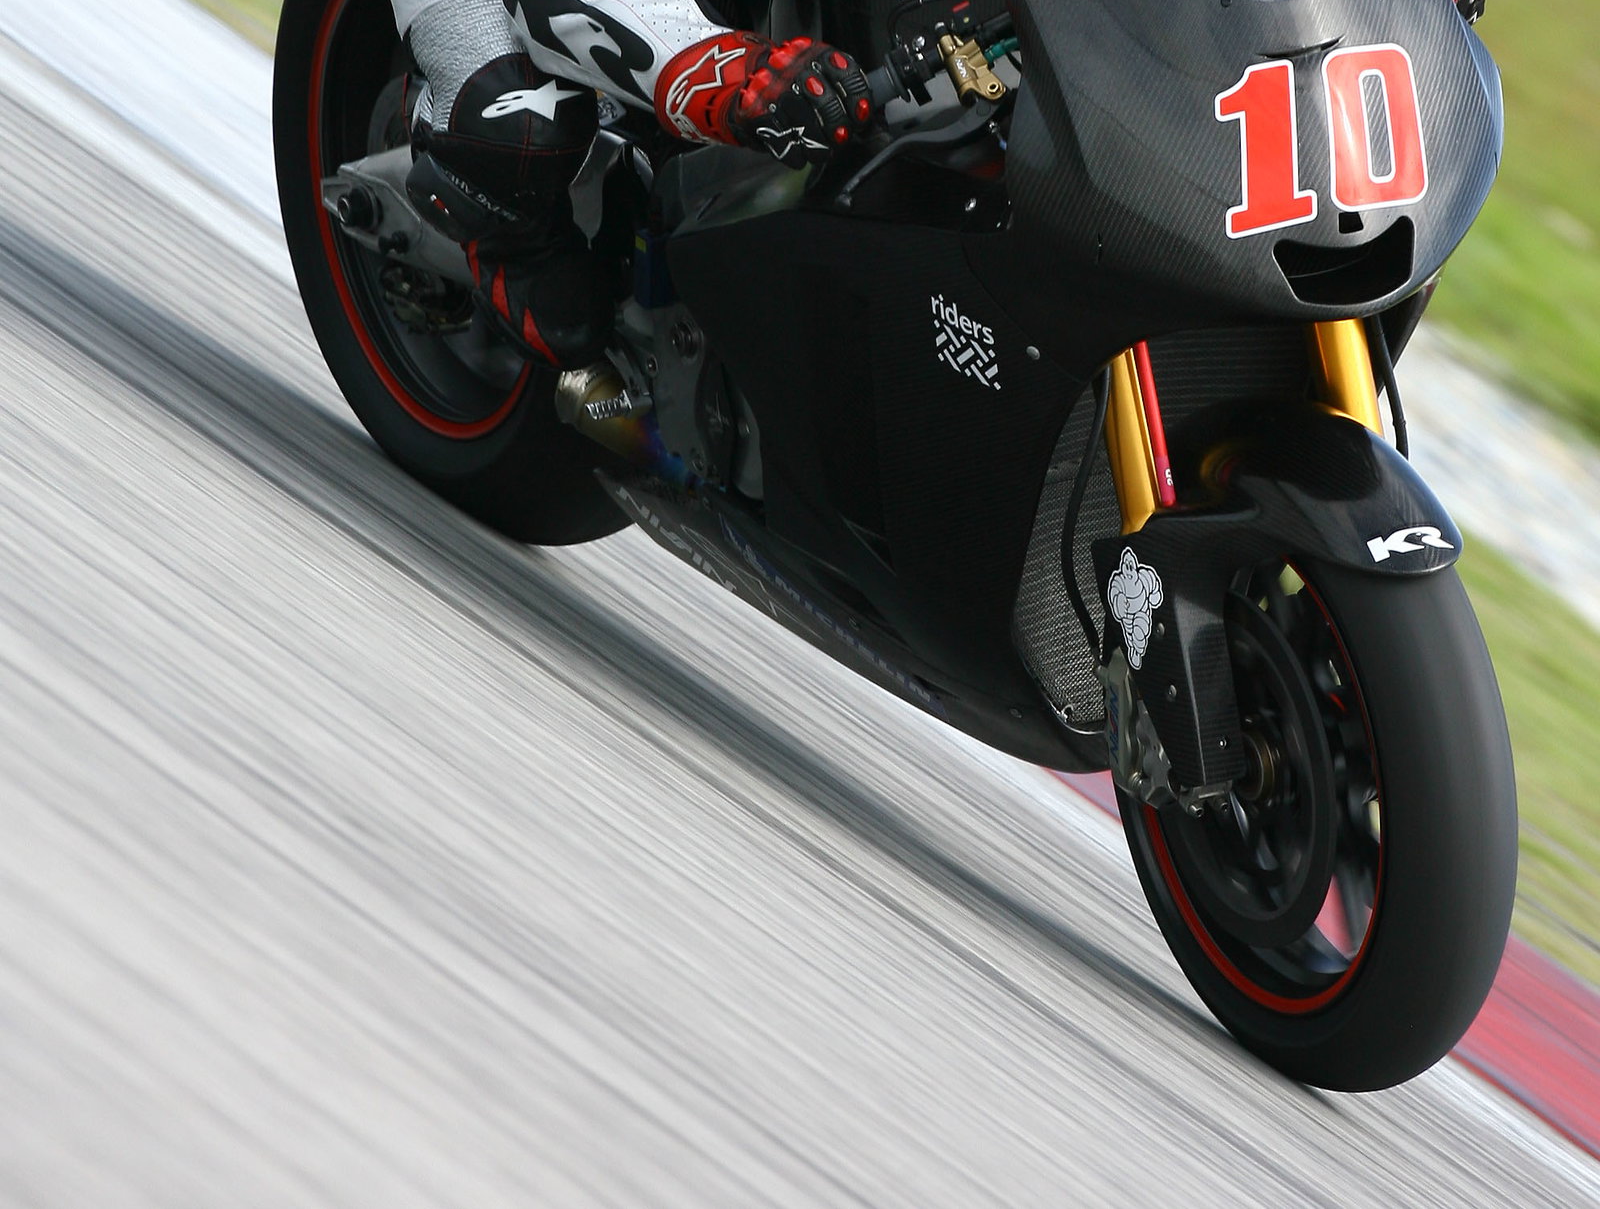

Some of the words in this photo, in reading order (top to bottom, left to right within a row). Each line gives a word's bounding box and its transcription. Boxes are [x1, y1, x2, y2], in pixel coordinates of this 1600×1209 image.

[1214, 43, 1429, 240] 10
[931, 293, 995, 345] riders
[1366, 526, 1456, 563] KR
